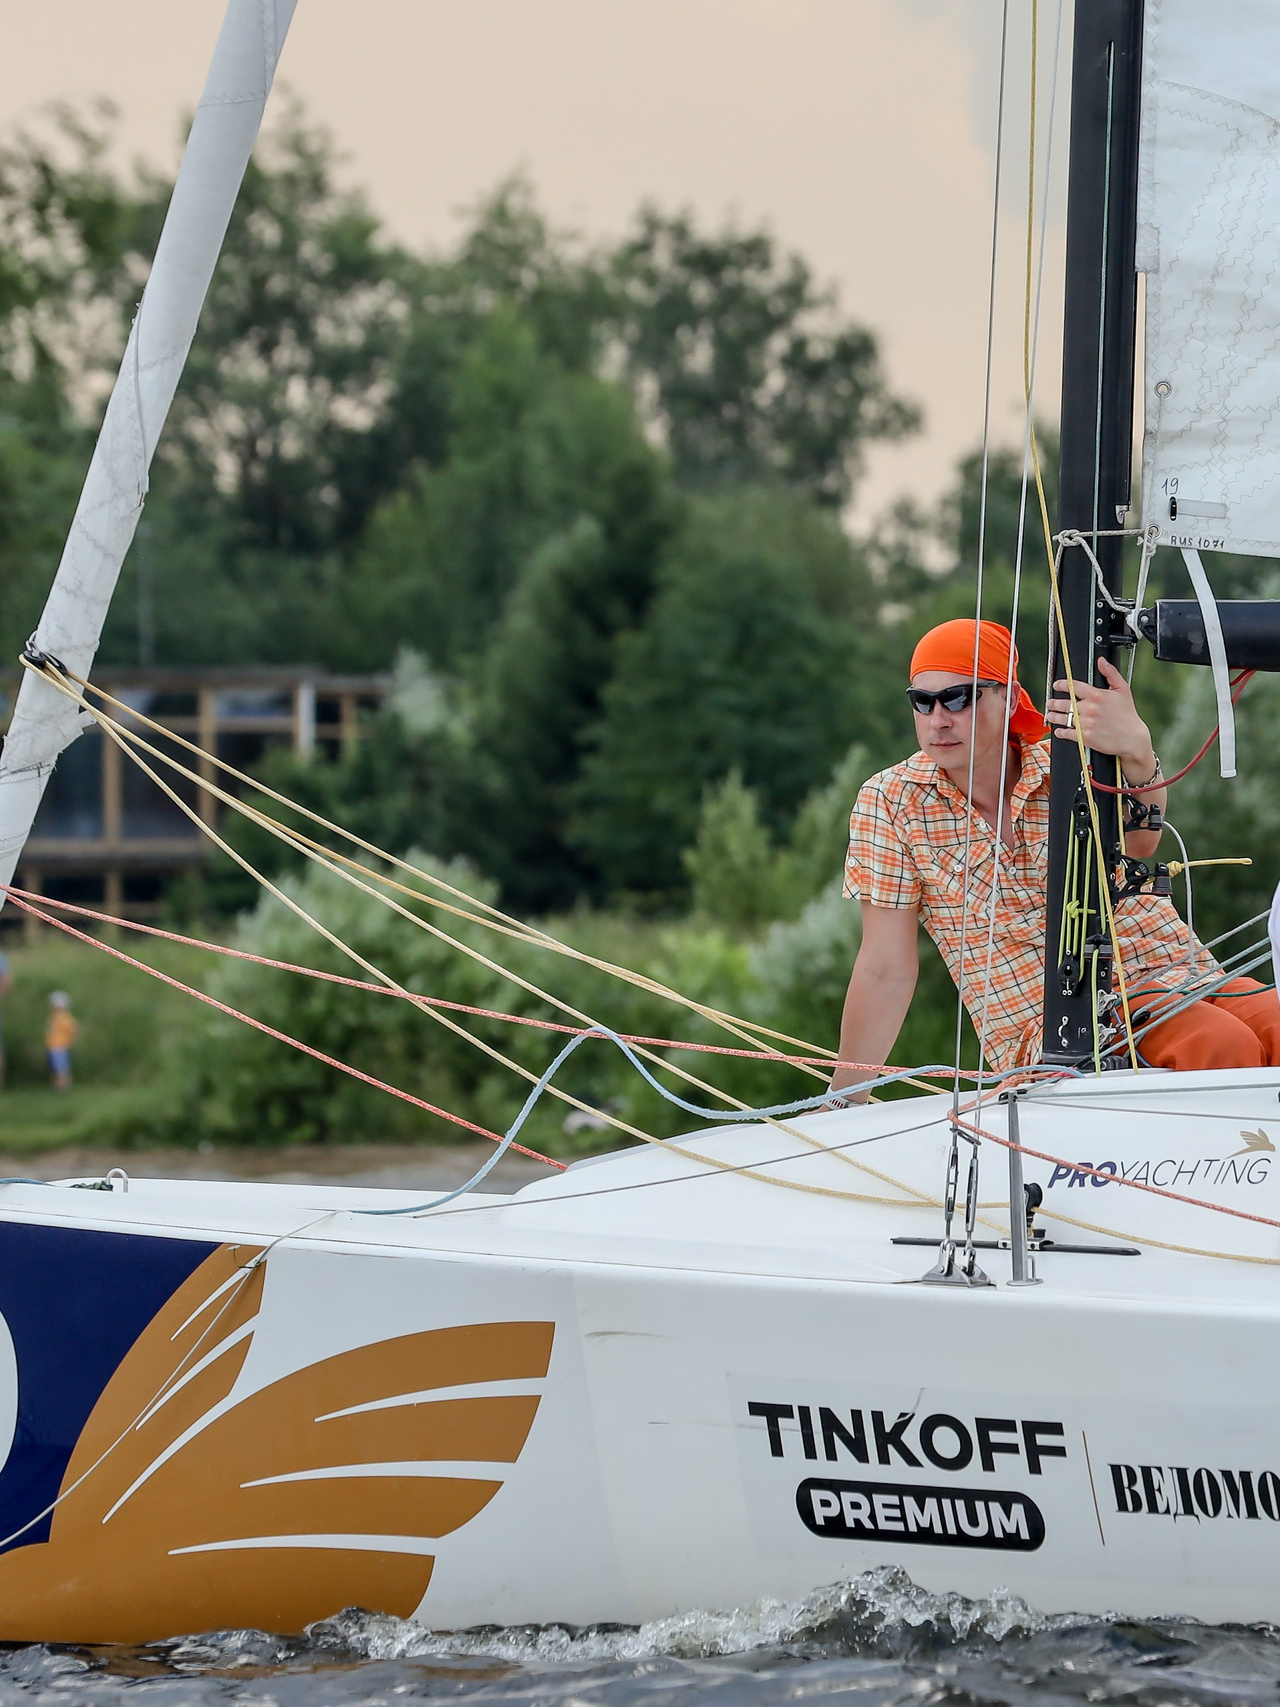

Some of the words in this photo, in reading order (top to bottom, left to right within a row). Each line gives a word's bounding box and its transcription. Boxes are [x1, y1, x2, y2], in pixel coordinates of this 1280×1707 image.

[1161, 477, 1179, 495] 19
[1170, 536, 1193, 546] RUS
[1047, 1158, 1272, 1188] PROYACHTING
[747, 1401, 1067, 1476] TINKOFF
[810, 1489, 1031, 1541] PREMIUM
